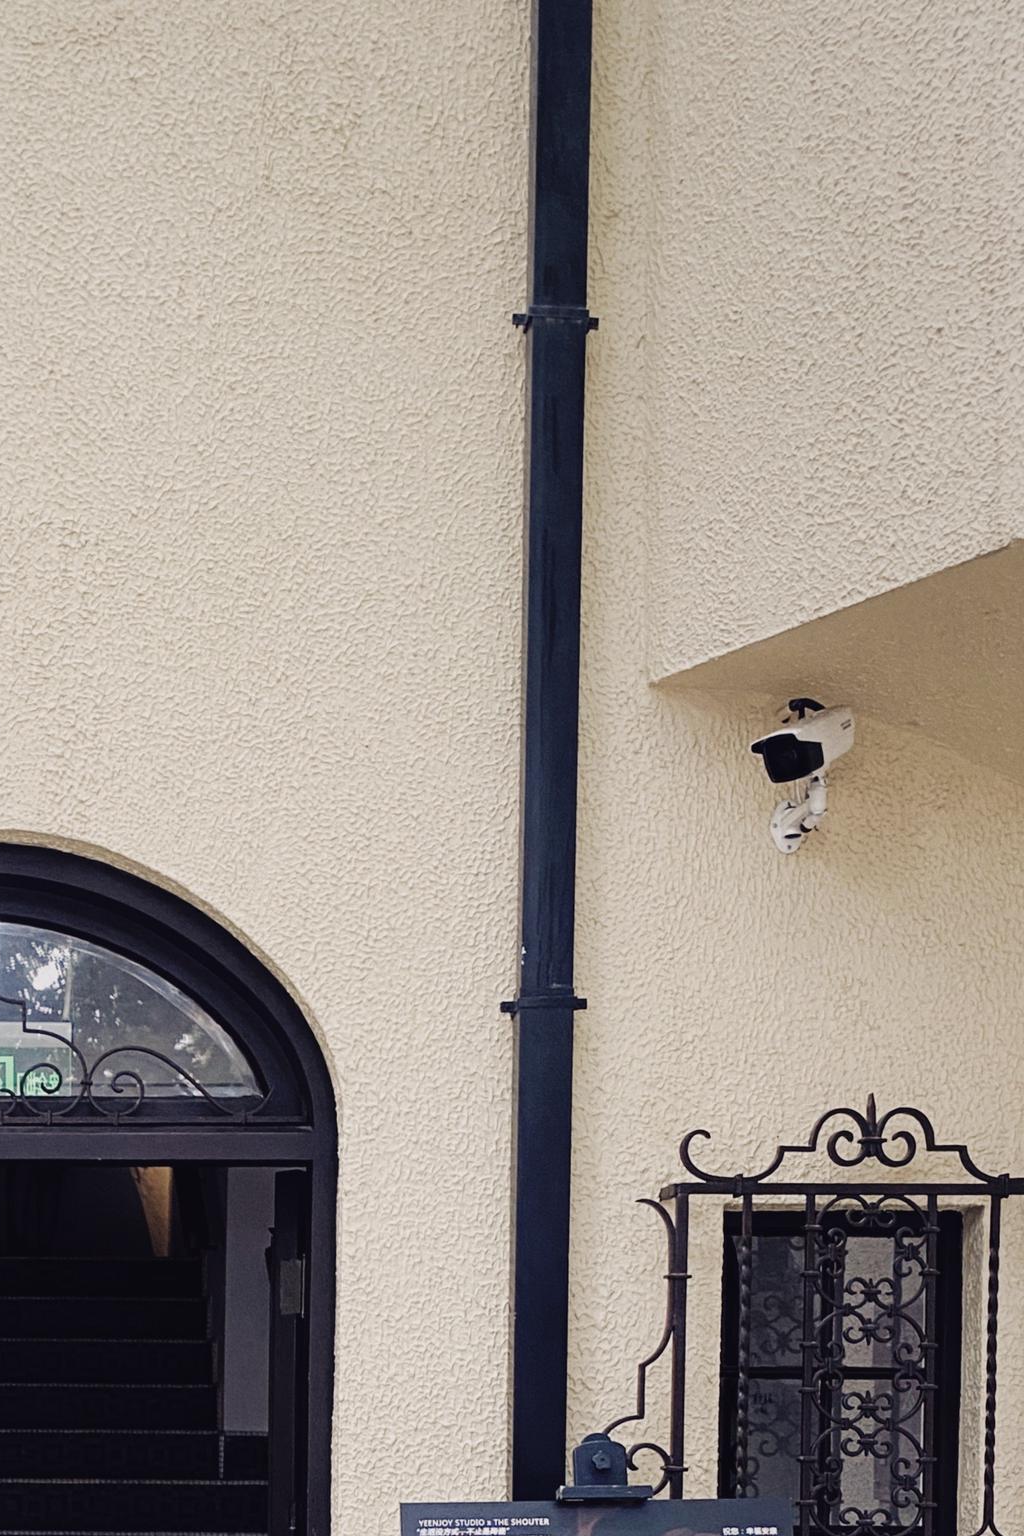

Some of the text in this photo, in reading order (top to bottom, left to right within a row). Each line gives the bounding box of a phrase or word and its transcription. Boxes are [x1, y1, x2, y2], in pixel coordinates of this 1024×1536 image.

[418, 1519, 453, 1527] YEENJOY
[455, 1519, 485, 1527] STUDIO
[494, 1518, 509, 1527] THE
[511, 1518, 550, 1526] SHOUTER
